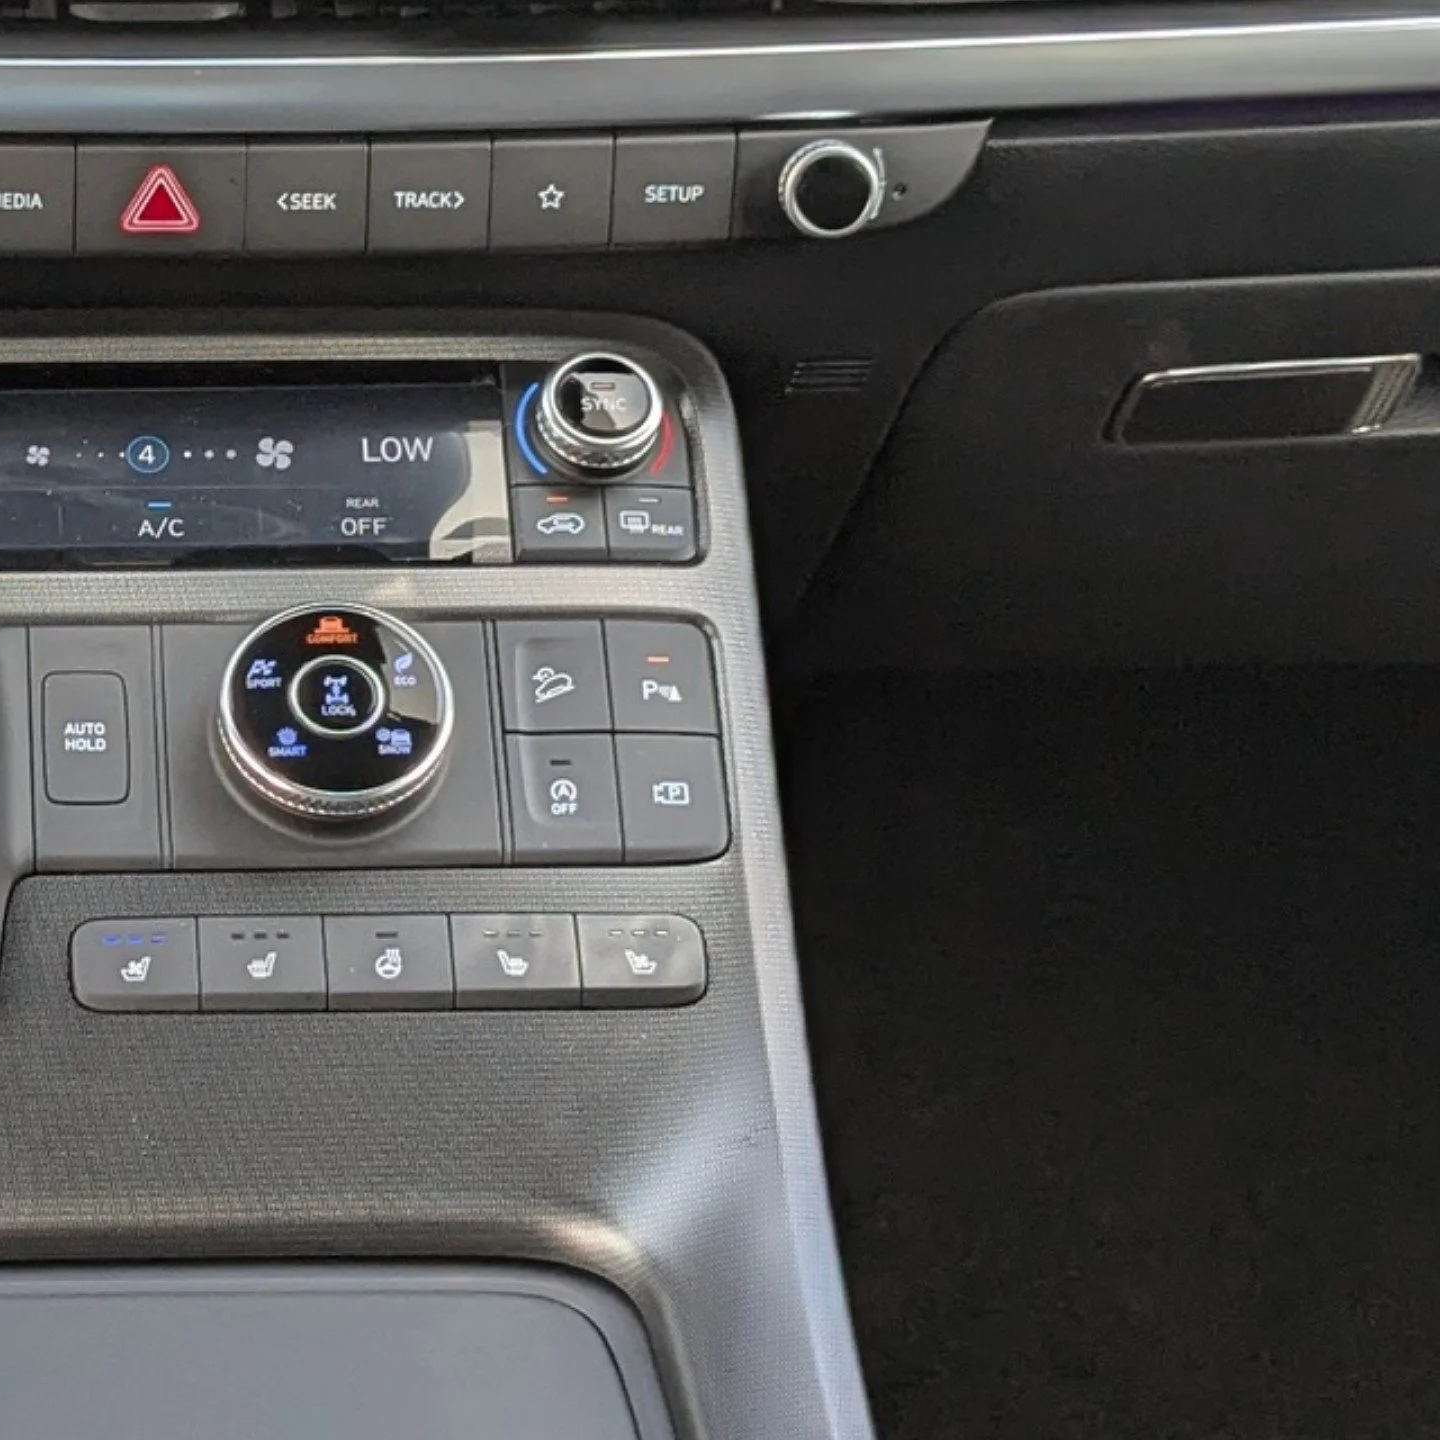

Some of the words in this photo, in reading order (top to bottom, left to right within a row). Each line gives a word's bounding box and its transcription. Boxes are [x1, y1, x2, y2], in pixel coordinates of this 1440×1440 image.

[644, 184, 704, 203] SETUP
[580, 398, 626, 411] SYNC
[137, 444, 155, 465] 4
[361, 437, 433, 462] LOW
[346, 497, 379, 509] REAR
[138, 518, 184, 538] A/C
[340, 518, 386, 537] OFF
[652, 524, 684, 536] REAR
[394, 676, 417, 686] ECO
[64, 723, 106, 737] AUTO
[64, 737, 107, 751] HOLD
[551, 803, 578, 815] OFF
